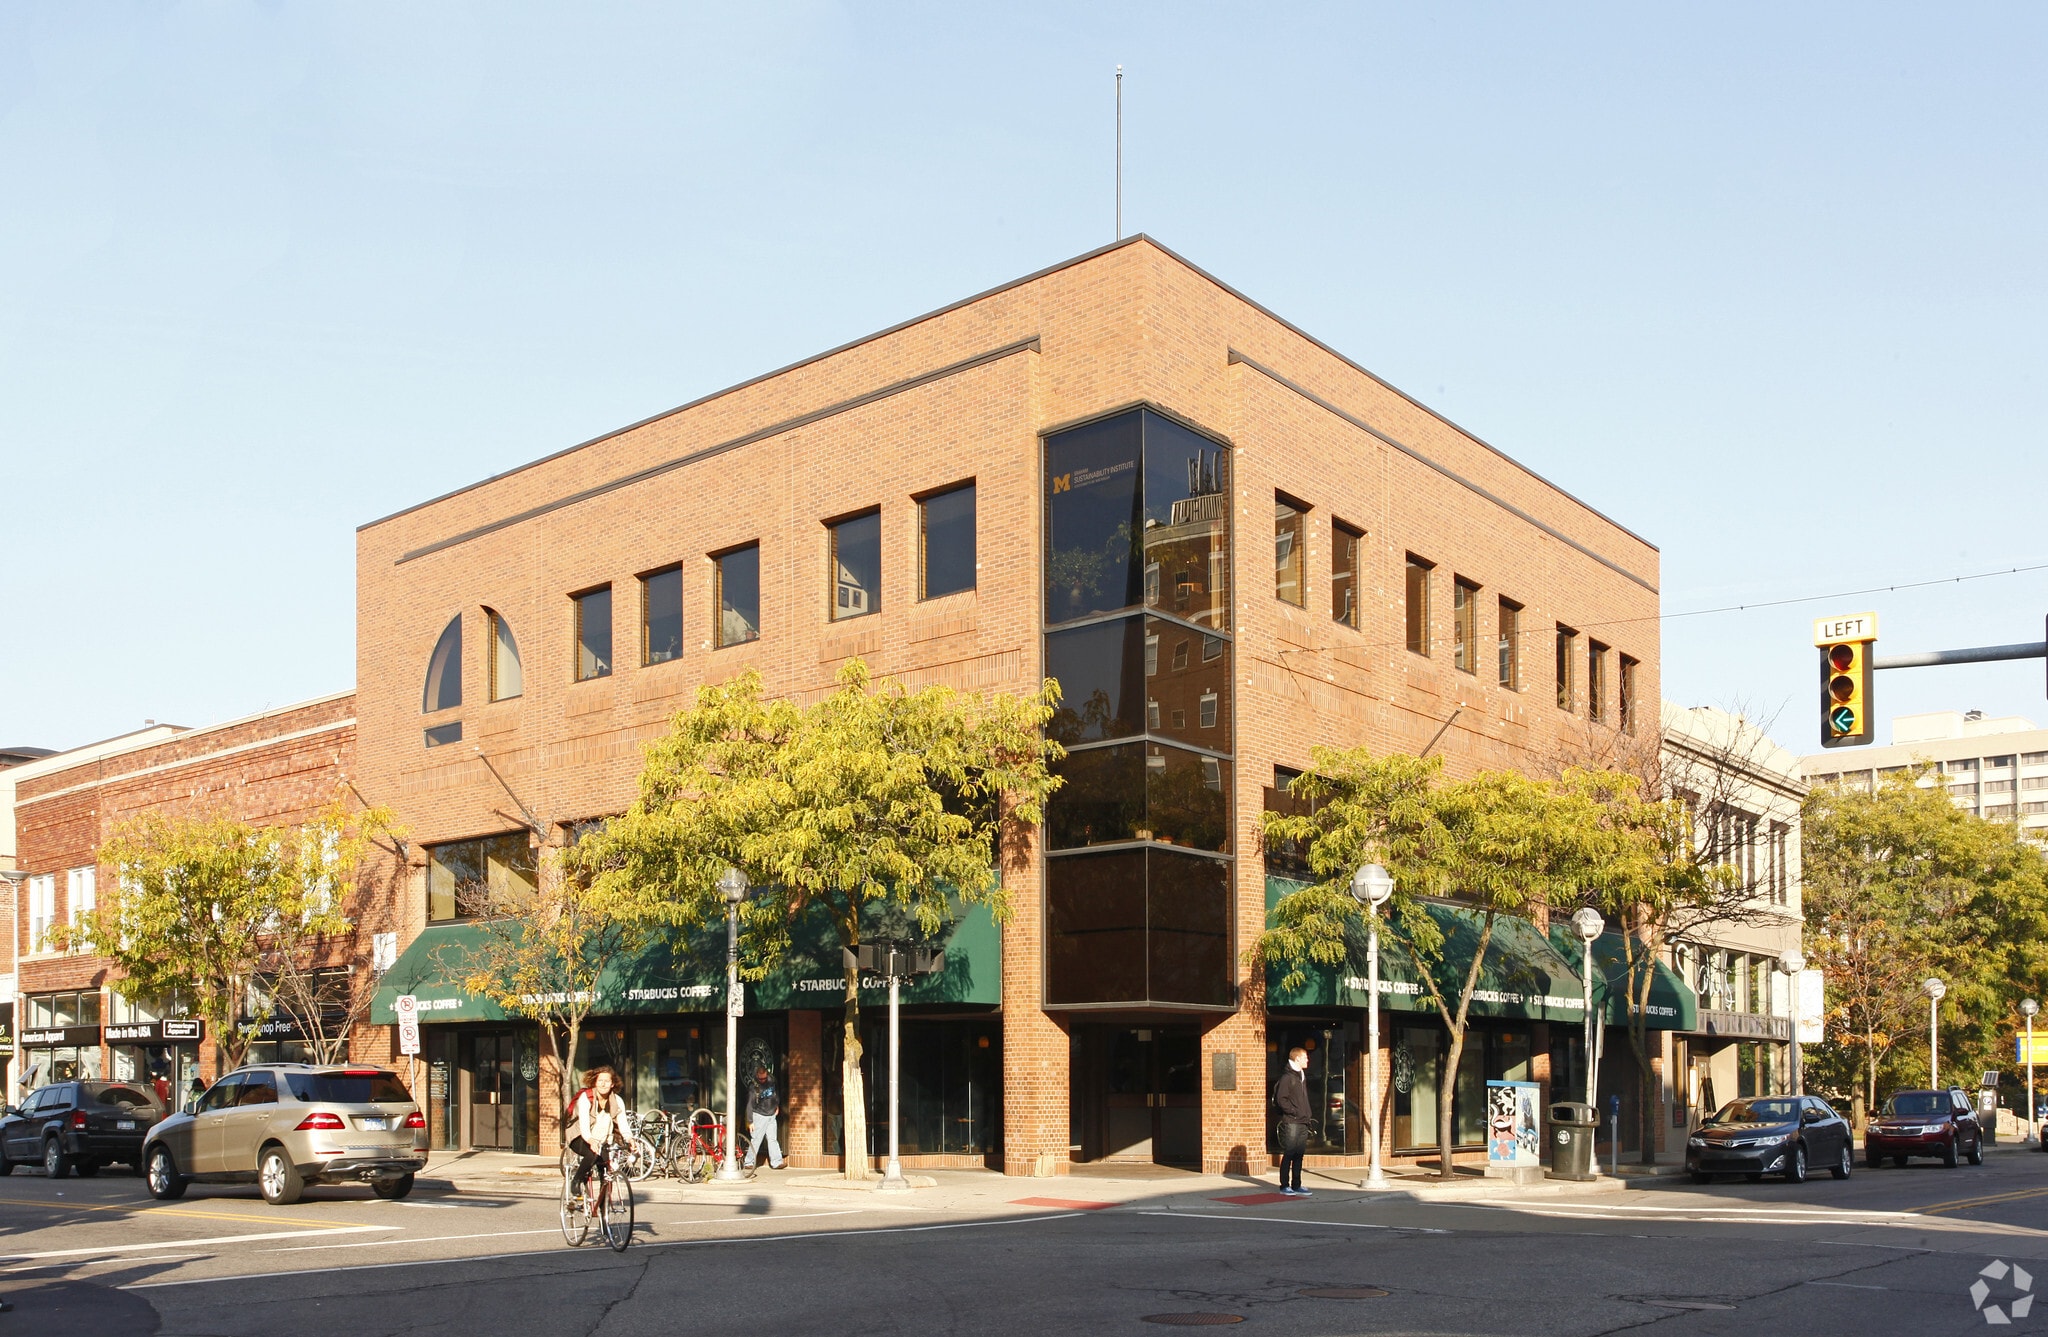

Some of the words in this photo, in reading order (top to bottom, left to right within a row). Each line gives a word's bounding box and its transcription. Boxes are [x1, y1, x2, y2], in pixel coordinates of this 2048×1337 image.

[1073, 468, 1110, 484] SUSTAINABILITY
[1110, 460, 1135, 474] INSTITUTE
[1053, 473, 1071, 494] M
[1825, 619, 1863, 638] LEFT
[628, 987, 678, 1000] STARBUCKS
[680, 985, 712, 998] COFFEE
[1393, 981, 1419, 995] COFFEE
[432, 998, 458, 1010] COFFEE
[1500, 992, 1520, 1004] COFFEE
[1533, 995, 1565, 1008] STARBUCKS
[1565, 998, 1585, 1009] COFFEE
[1659, 1006, 1674, 1016] COFFEE
[105, 1027, 121, 1039] Made
[121, 1027, 127, 1038] in
[127, 1026, 138, 1038] the
[138, 1025, 151, 1038] USA
[166, 1022, 196, 1030] American
[275, 1021, 291, 1032] Free
[21, 1031, 45, 1043] American
[44, 1029, 65, 1044] Apparel
